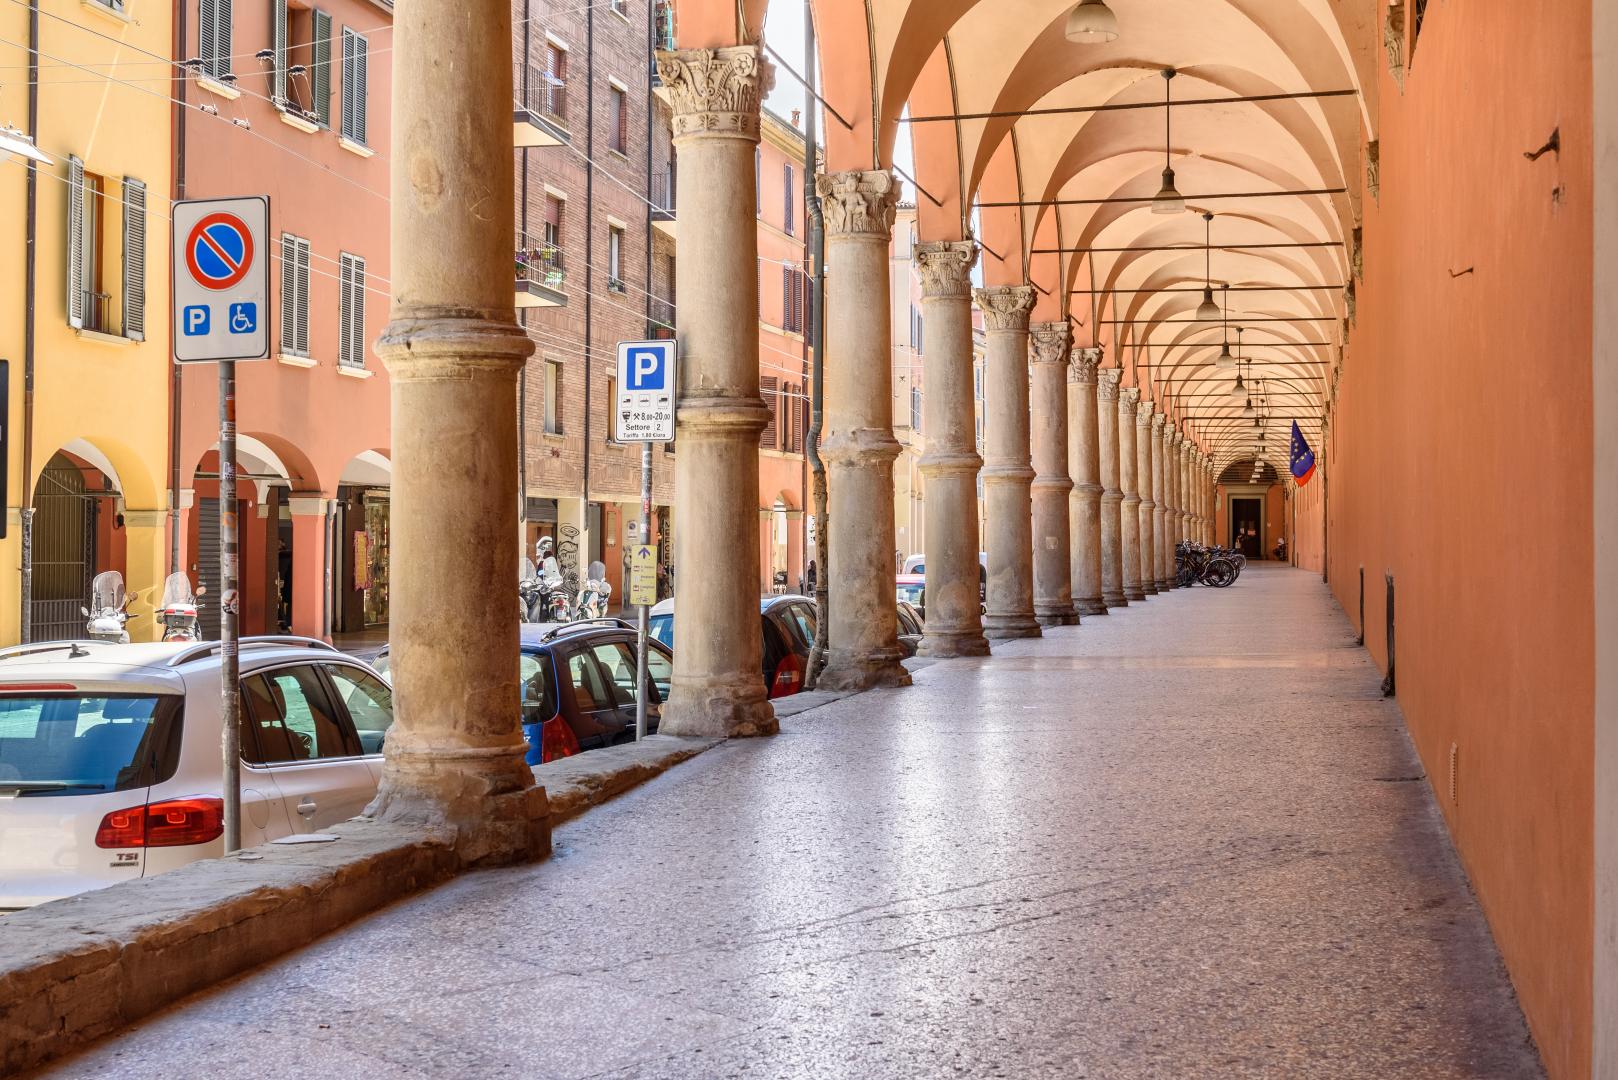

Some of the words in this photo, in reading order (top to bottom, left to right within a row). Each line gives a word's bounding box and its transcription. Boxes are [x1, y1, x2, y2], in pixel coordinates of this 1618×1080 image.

[189, 308, 206, 333] P
[634, 352, 658, 387] P
[625, 423, 651, 431] Settore
[656, 423, 661, 431] 2
[116, 852, 139, 861] TSI
